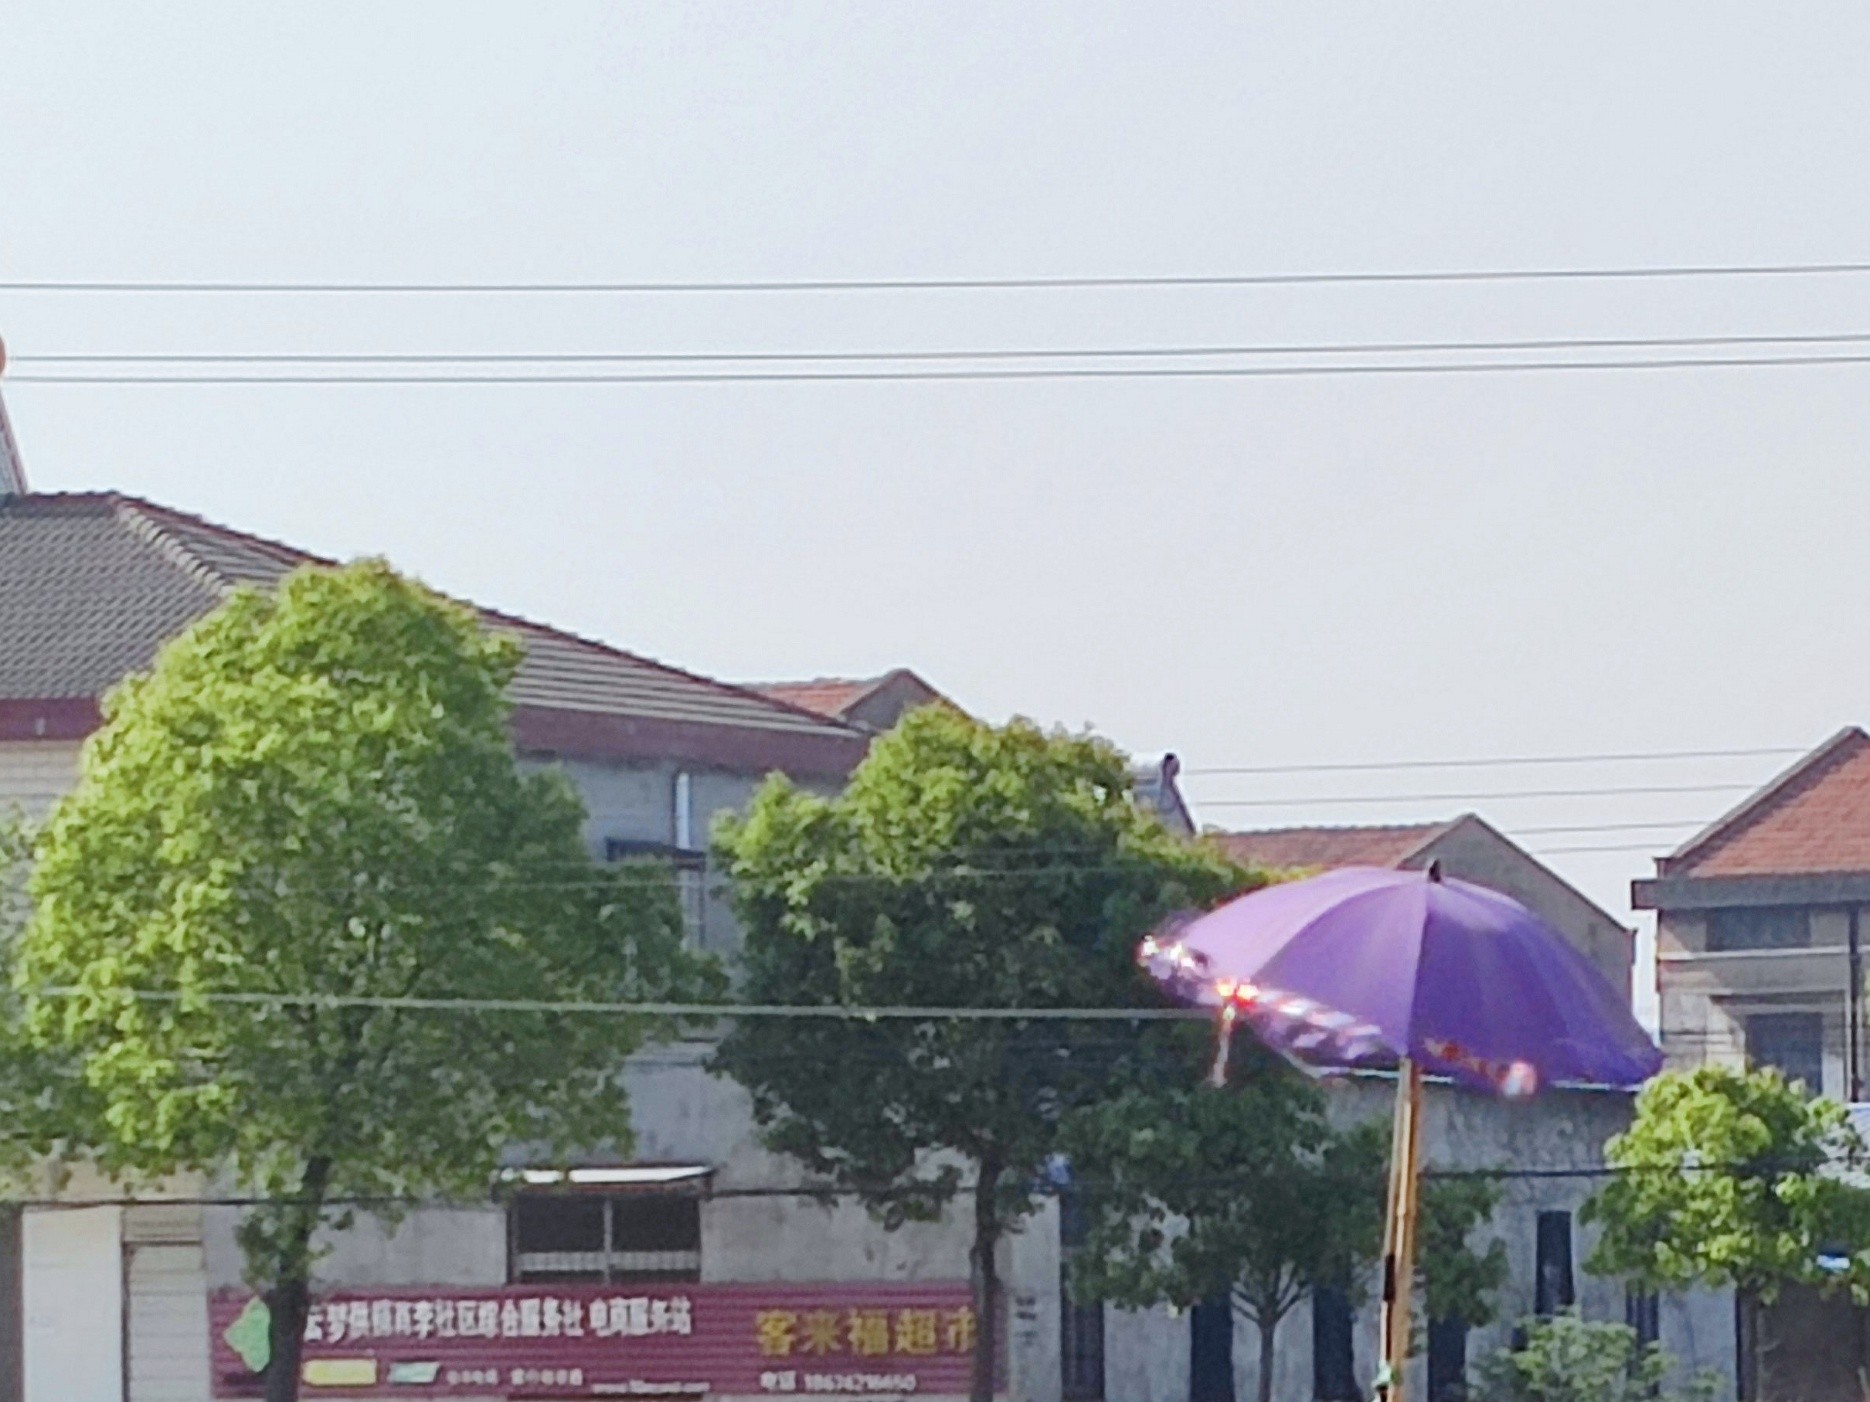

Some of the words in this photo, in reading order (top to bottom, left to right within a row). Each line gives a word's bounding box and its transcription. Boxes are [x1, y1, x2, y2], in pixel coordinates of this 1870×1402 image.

[755, 1305, 978, 1357] 客来福超市
[760, 1370, 796, 1391] 电话
